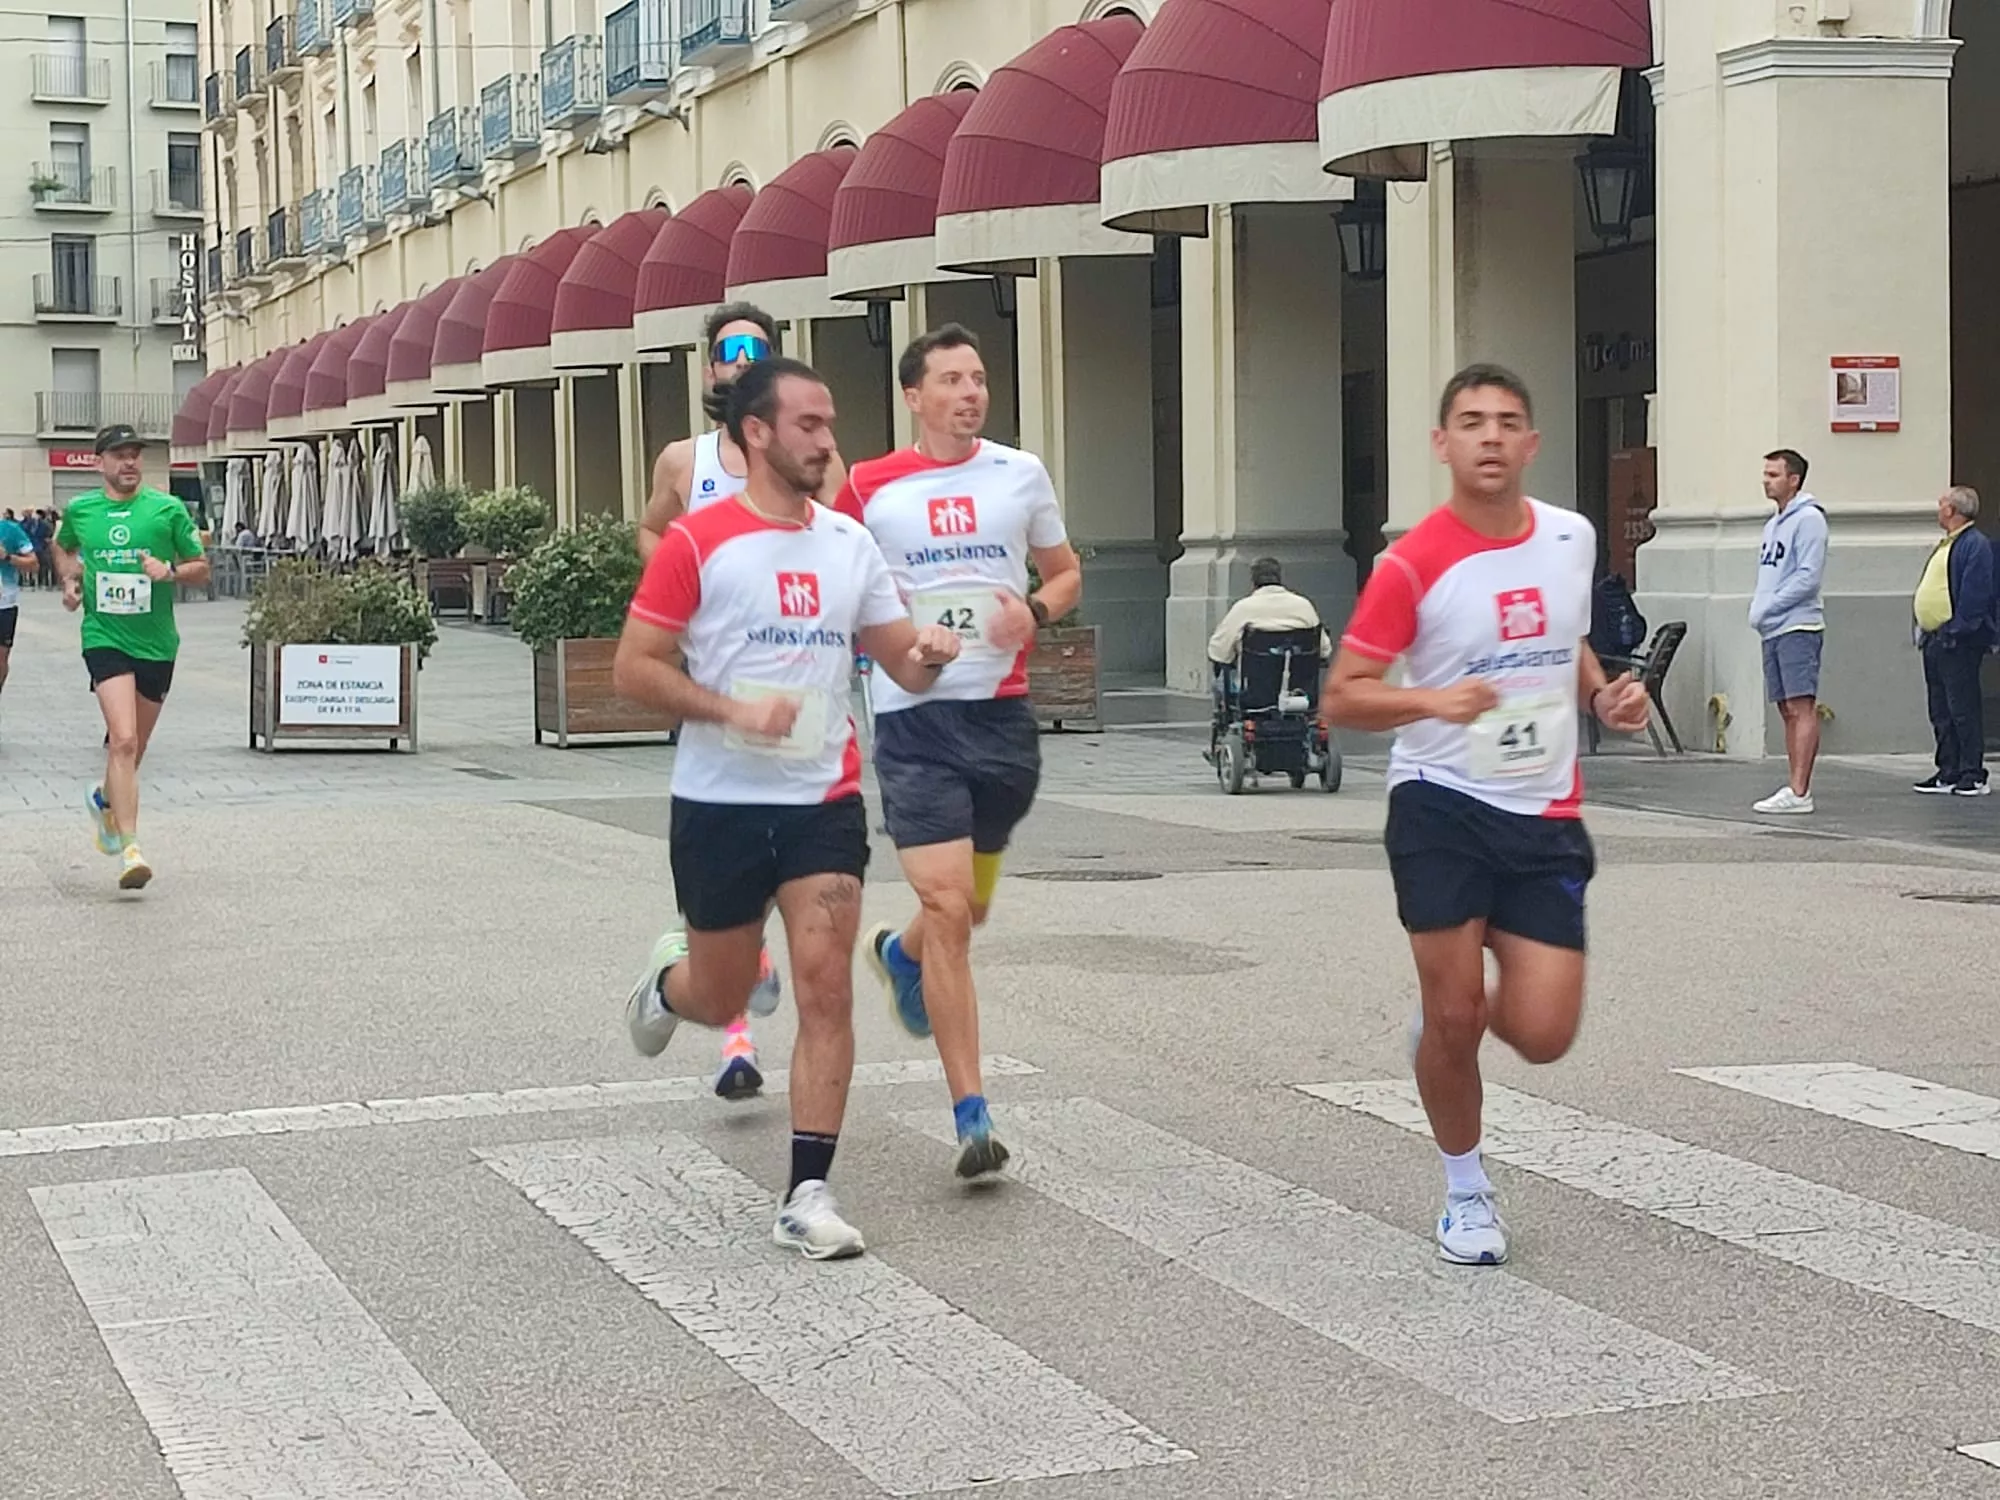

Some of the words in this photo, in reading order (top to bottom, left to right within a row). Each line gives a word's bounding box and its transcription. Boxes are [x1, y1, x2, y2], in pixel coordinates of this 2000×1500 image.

[181, 233, 197, 340] HOSTAL
[905, 541, 1008, 567] salesianos
[105, 587, 136, 602] 401
[937, 608, 976, 629] 42
[746, 624, 846, 647] salesianos
[297, 680, 323, 689] ZONA
[325, 680, 337, 689] DE
[340, 680, 384, 690] ESTANCIA
[1498, 721, 1538, 746] 41
